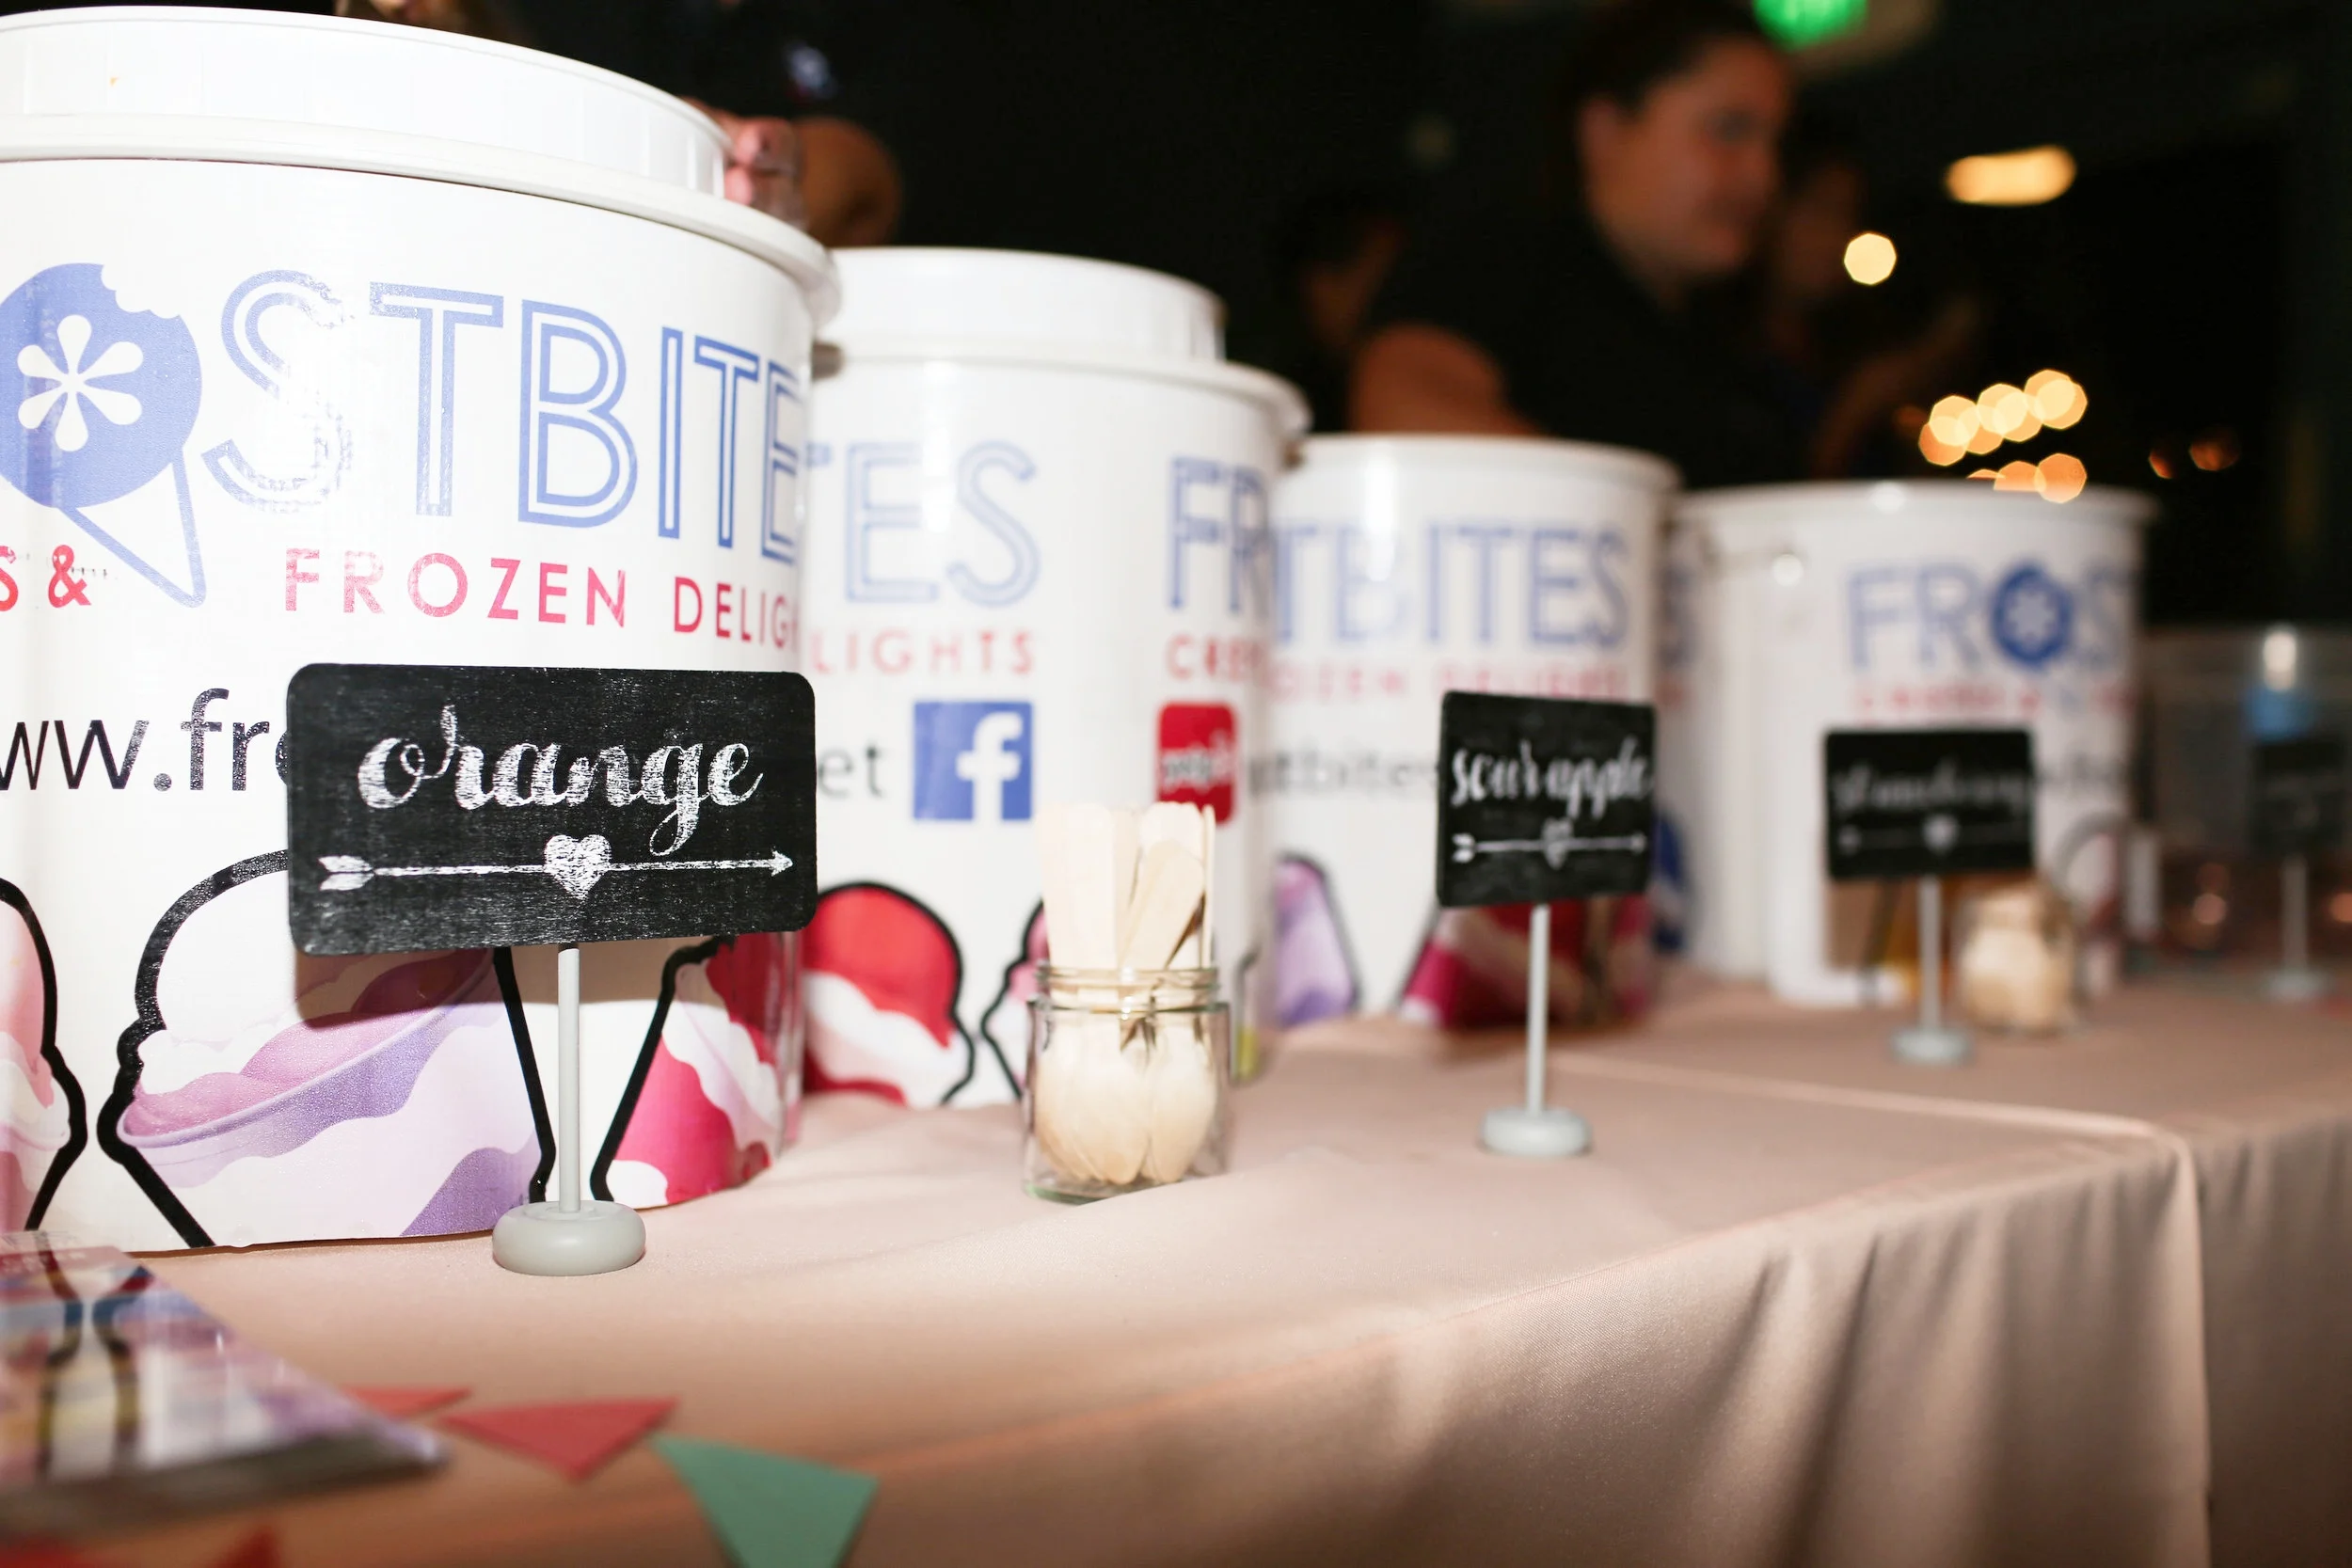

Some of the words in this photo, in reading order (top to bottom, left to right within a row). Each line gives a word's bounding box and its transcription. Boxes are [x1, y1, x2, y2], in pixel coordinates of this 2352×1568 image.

[48, 544, 92, 609] &
[285, 546, 627, 628] FROZEN
[358, 705, 764, 857] orange
